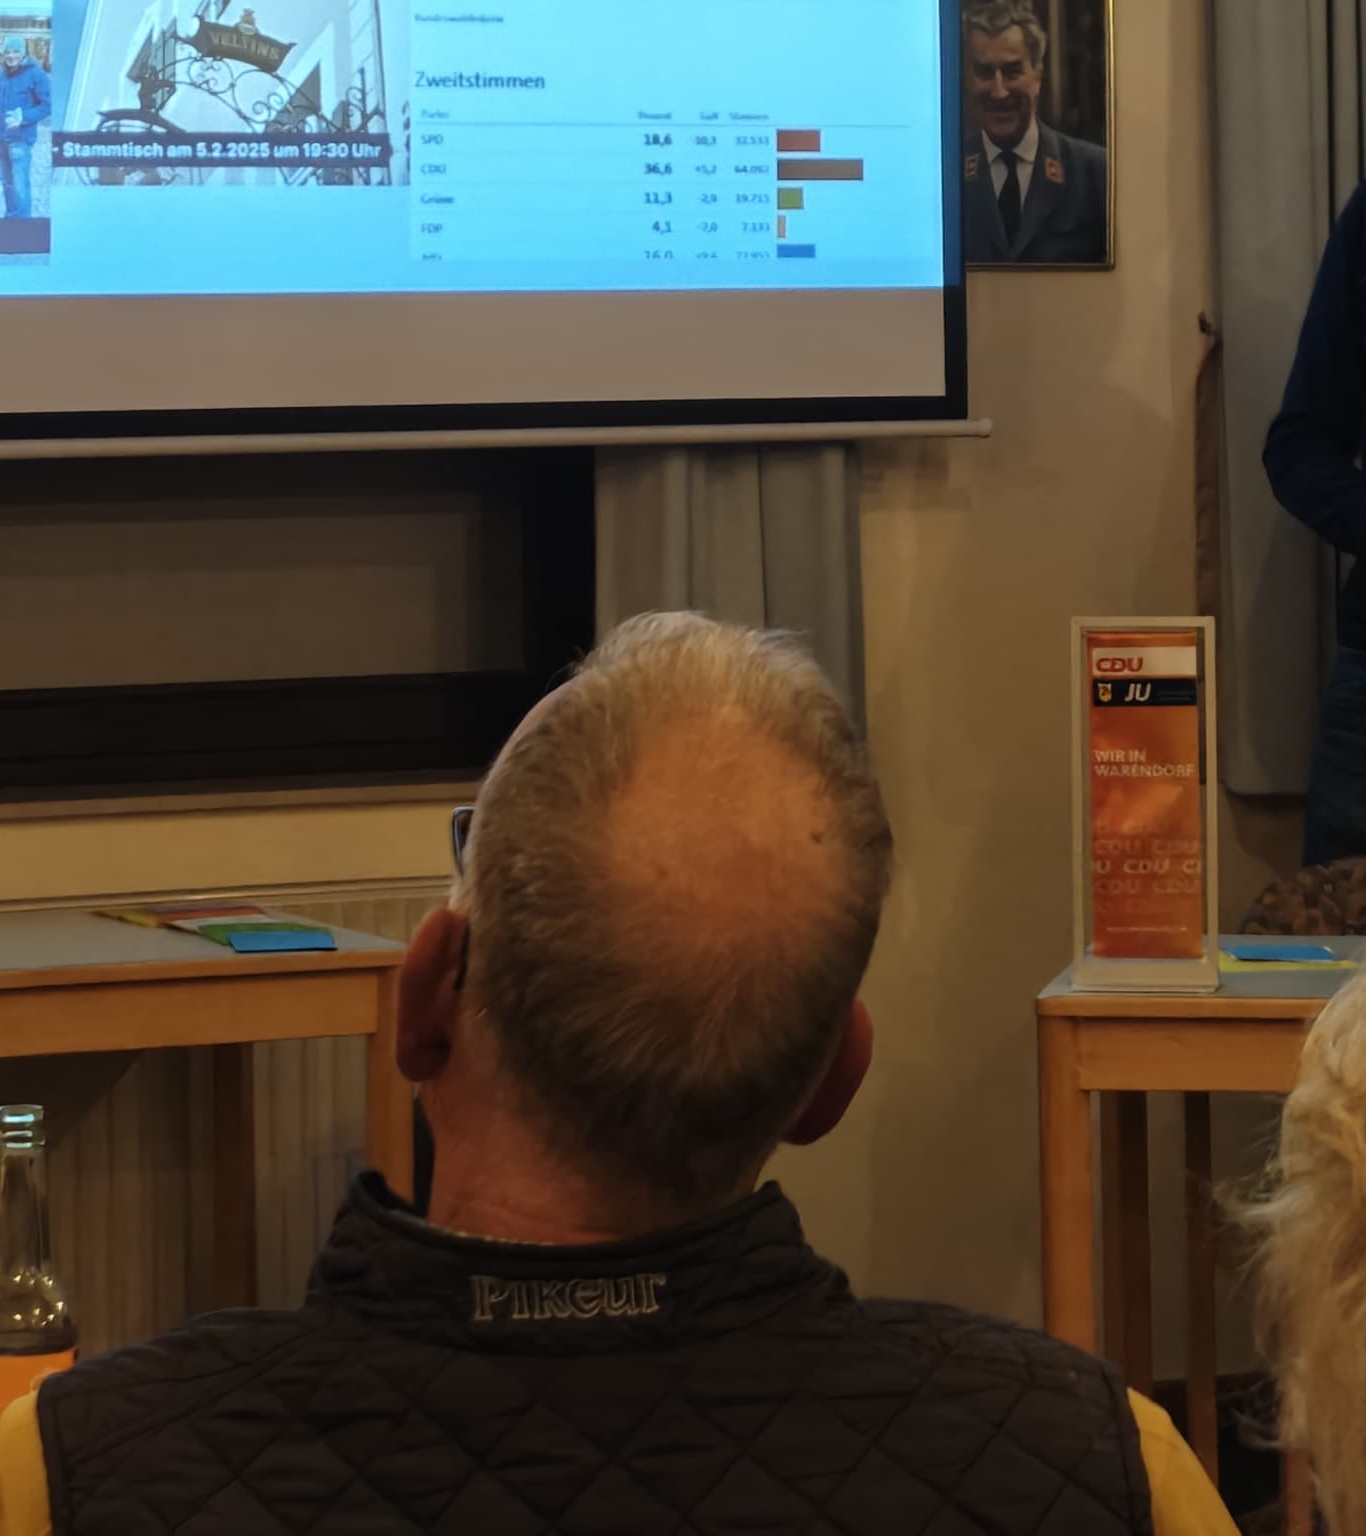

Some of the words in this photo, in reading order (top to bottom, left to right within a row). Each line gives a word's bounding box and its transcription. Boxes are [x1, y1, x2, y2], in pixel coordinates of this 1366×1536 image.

[415, 71, 547, 90] Zweitstimmen
[420, 134, 444, 145] SPD
[643, 133, 673, 148] 18,6
[63, 141, 163, 160] Stammtisch
[166, 144, 193, 159] am
[195, 142, 271, 159] 5.2.2025
[273, 145, 300, 159] um
[302, 142, 349, 159] 19:30
[351, 143, 382, 160] Uhr
[644, 162, 673, 177] 36,6
[643, 191, 673, 206] 11,3
[420, 223, 443, 235] FDP
[651, 220, 673, 234] 4,1
[1095, 657, 1144, 673] CDU
[1123, 682, 1153, 703] JU
[1093, 749, 1127, 764] WIR
[1128, 749, 1147, 763] IN
[1094, 764, 1196, 778] WARENDORF
[1123, 857, 1170, 874] CDU
